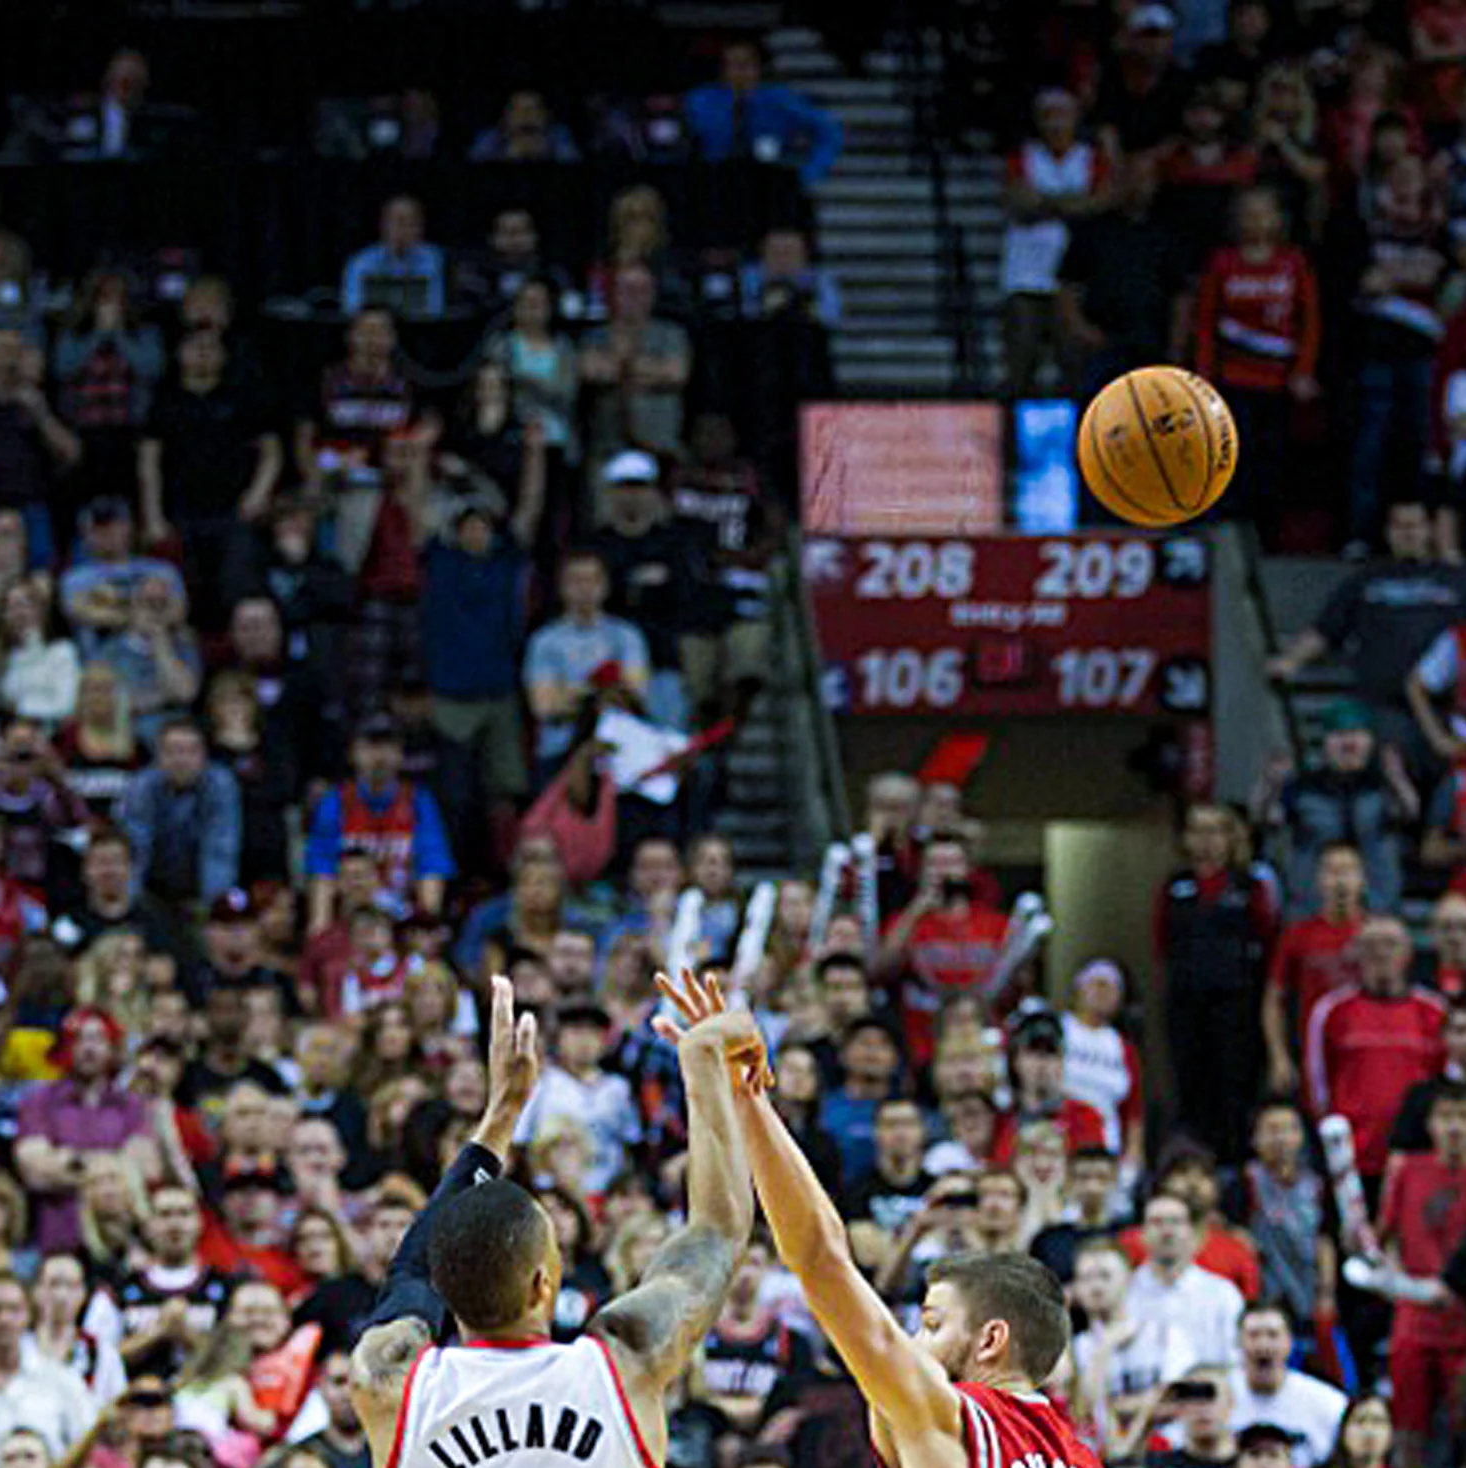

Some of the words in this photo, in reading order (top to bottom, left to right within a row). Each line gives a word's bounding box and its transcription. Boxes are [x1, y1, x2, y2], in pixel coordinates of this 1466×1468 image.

[854, 540, 976, 598] 208
[1034, 540, 1155, 598] 209
[857, 647, 963, 706] 106
[1051, 647, 1156, 706] 107
